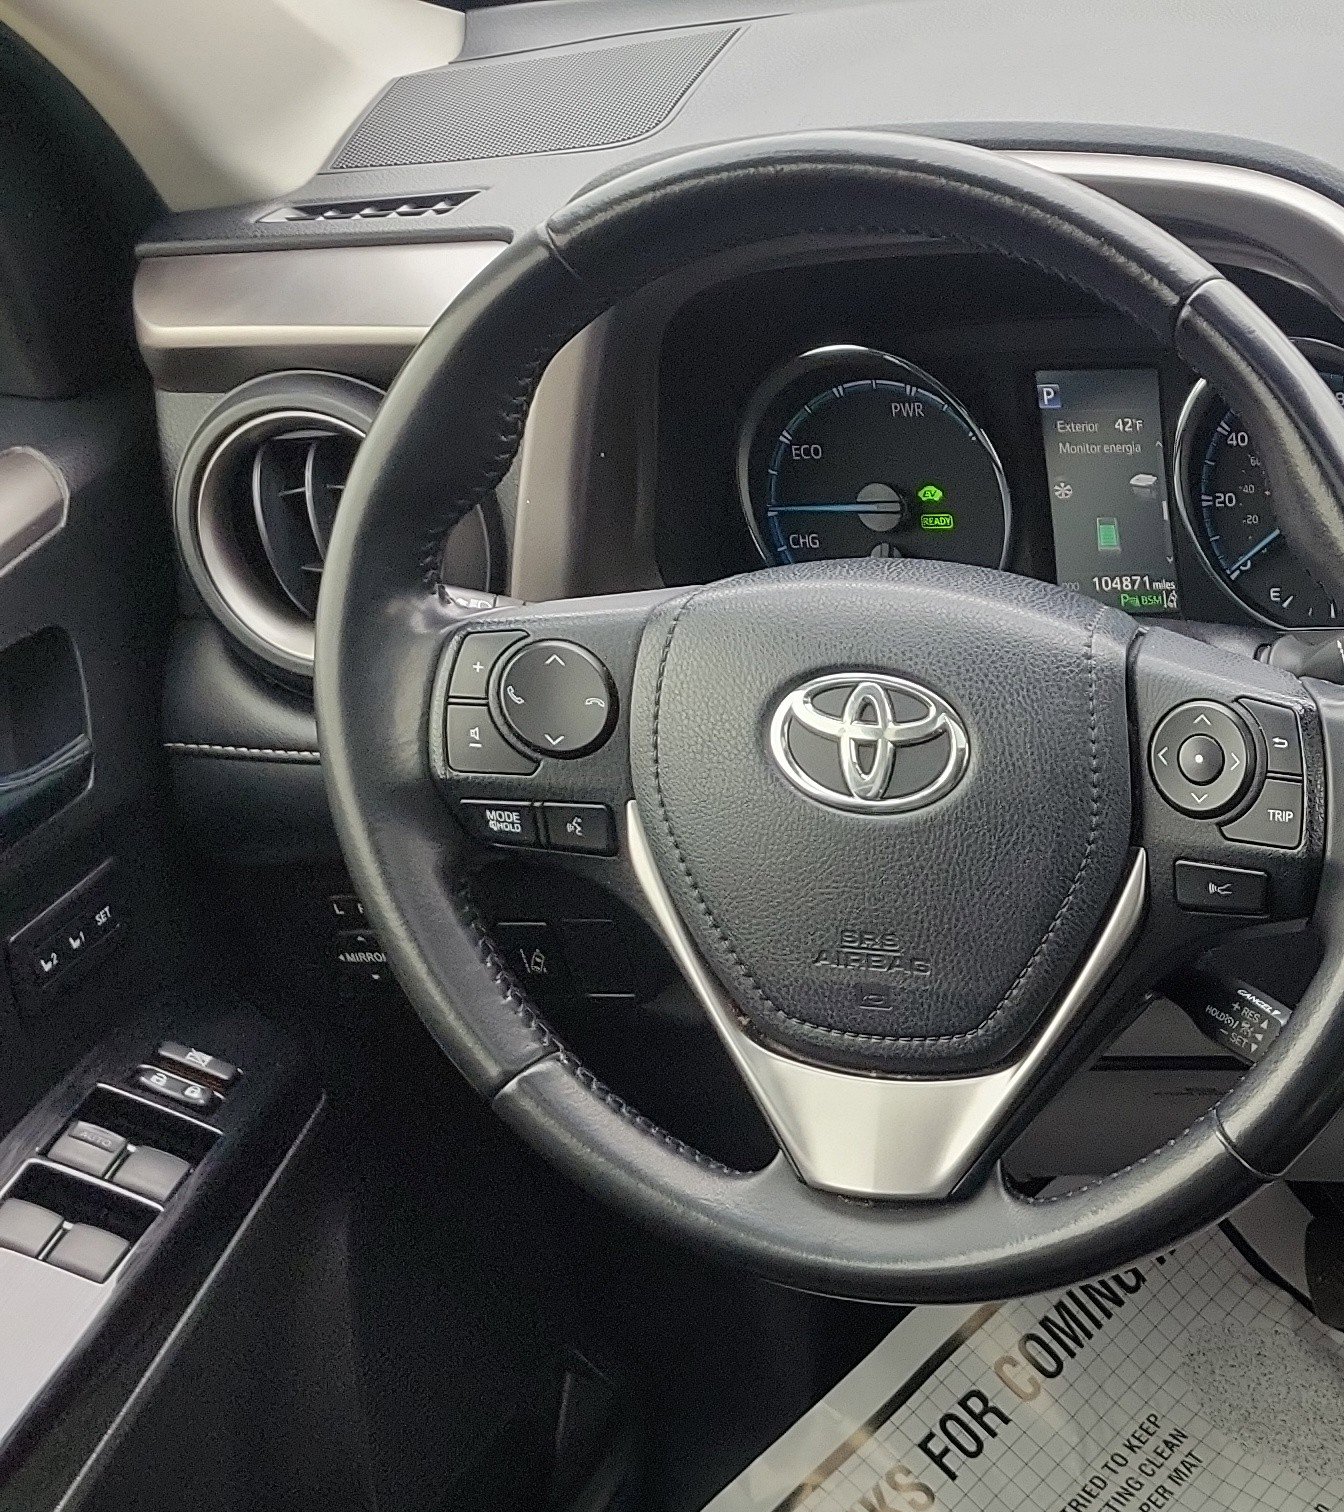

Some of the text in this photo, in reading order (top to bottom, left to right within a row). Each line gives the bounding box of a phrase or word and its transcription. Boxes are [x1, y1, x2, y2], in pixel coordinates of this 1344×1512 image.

[1043, 387, 1055, 405] P
[891, 402, 924, 417] PWR
[1056, 420, 1098, 433] Exterior
[1226, 431, 1249, 447] 40
[791, 444, 822, 460] ECO
[1058, 442, 1100, 454] Monitor
[1215, 493, 1236, 507] 20
[922, 516, 951, 526] READY
[789, 533, 820, 549] CHG
[1092, 575, 1151, 592] 104871
[1152, 578, 1176, 590] miles
[1141, 594, 1162, 605] BSM
[1269, 587, 1281, 601] E
[485, 810, 521, 824] MODE
[1268, 809, 1294, 823] TRIP
[496, 820, 522, 833] HOLD
[95, 905, 112, 926] SET
[917, 1388, 1012, 1482] FOR
[1101, 1452, 1129, 1475] TO
[1122, 1412, 1162, 1455] KEEP
[1138, 1427, 1189, 1478] CLEAN
[1167, 1450, 1204, 1487] MAT
